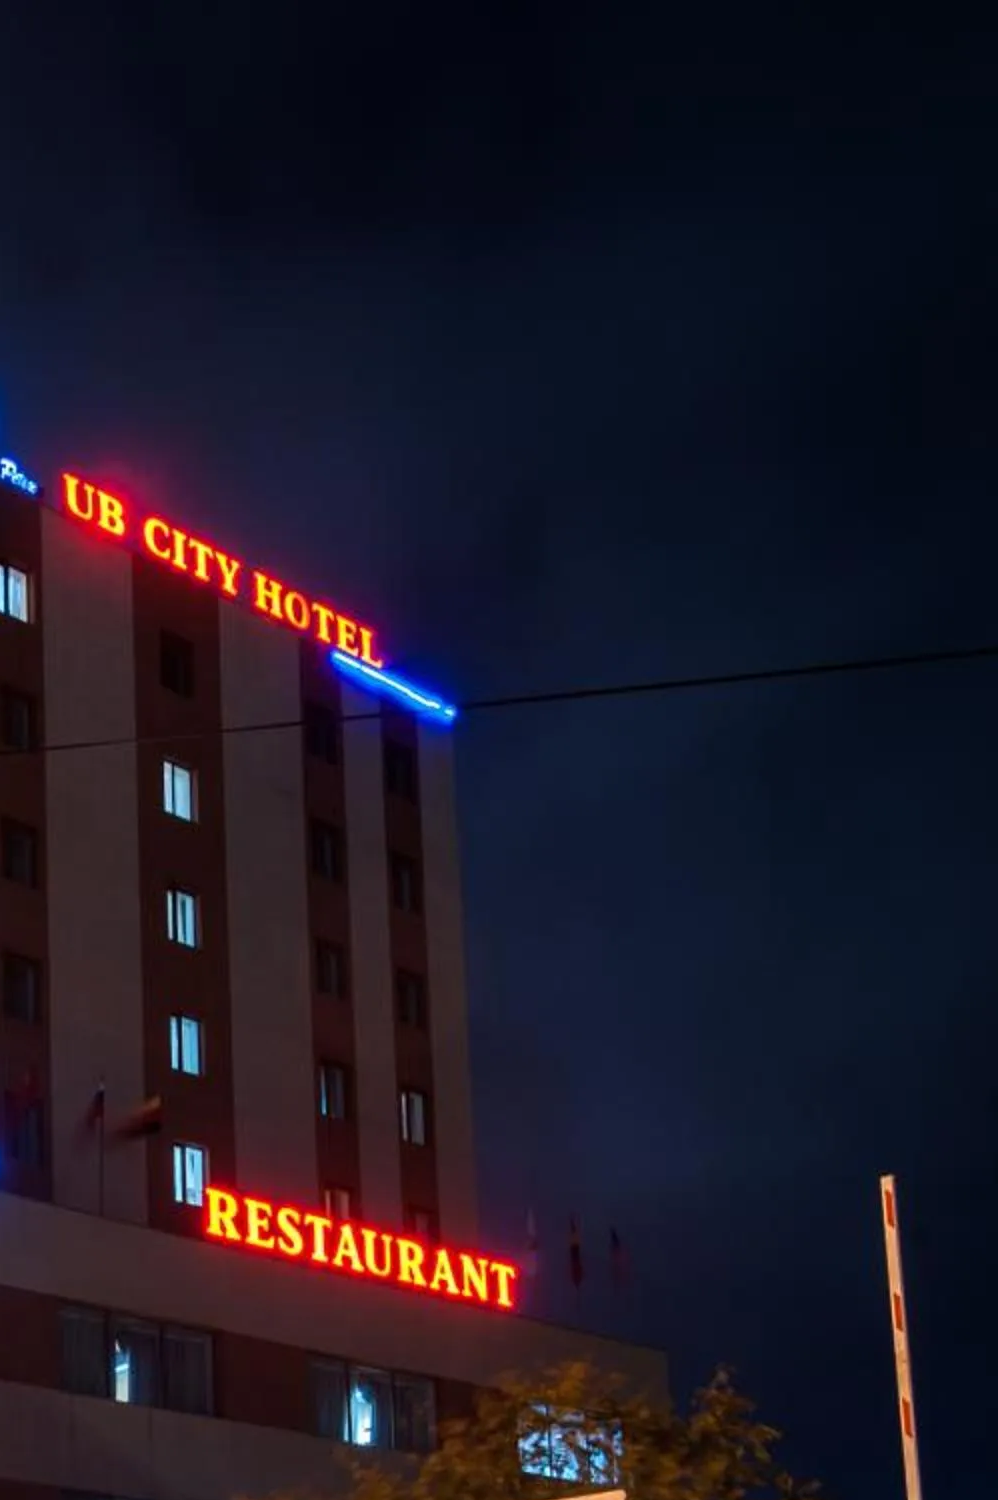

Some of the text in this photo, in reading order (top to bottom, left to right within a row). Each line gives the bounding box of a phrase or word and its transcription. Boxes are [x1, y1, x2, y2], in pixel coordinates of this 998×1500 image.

[62, 473, 384, 670] UB CITY HOTEL
[204, 1185, 517, 1309] RESTAURANT
